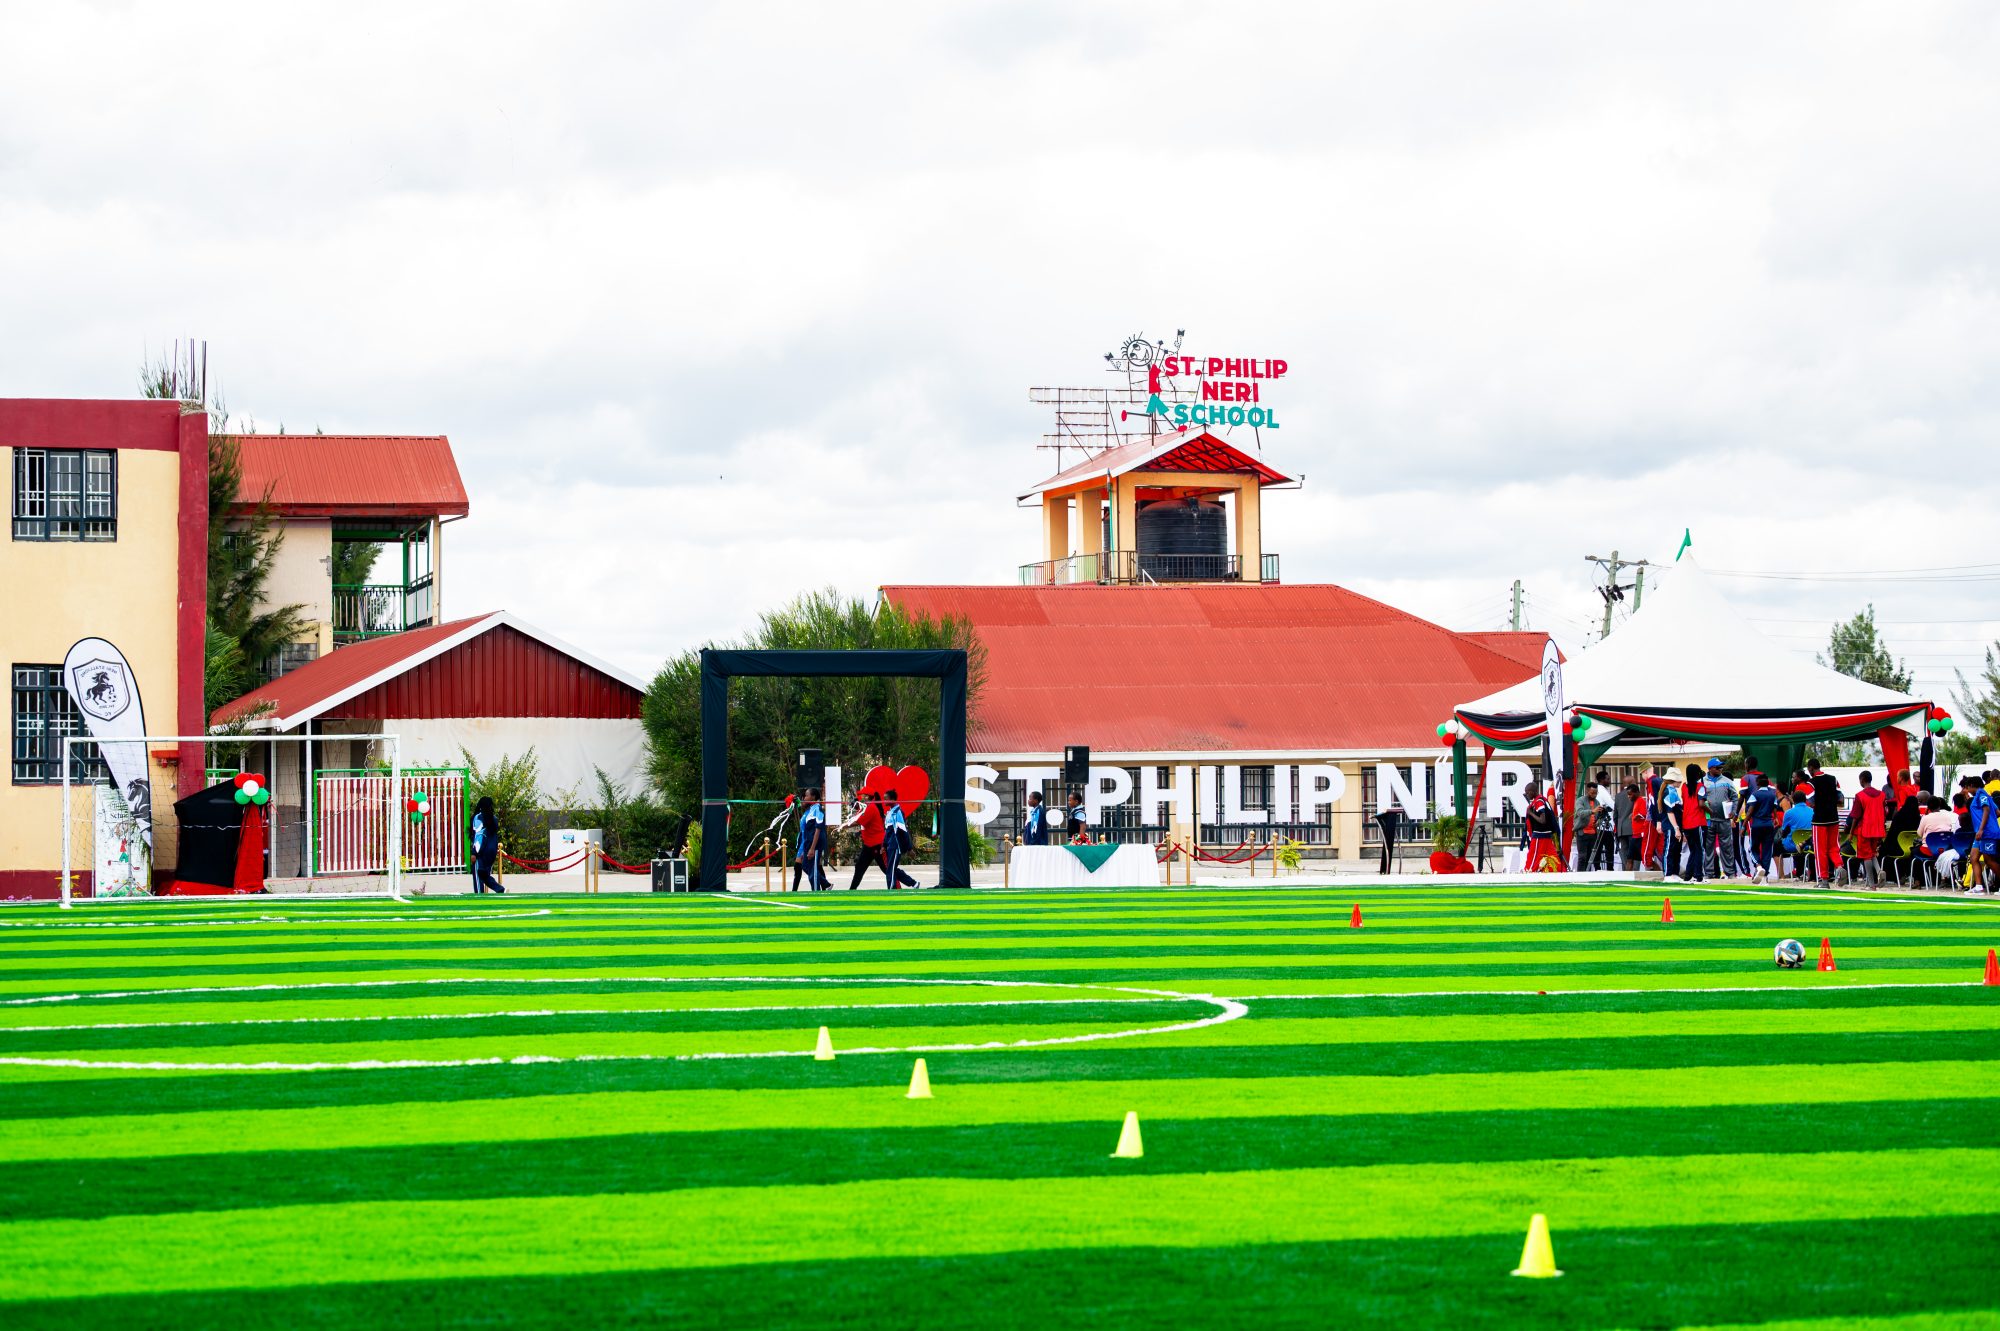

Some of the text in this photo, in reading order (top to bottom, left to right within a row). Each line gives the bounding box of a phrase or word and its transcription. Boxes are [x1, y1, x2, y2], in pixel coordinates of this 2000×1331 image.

[1164, 356, 1288, 379] ST. PHILIP
[1202, 380, 1259, 402] NERI
[1174, 404, 1280, 429] SCHOOL
[965, 764, 1064, 826] ST.
[1084, 764, 1347, 825] PHILIP
[1376, 760, 1557, 820] NER
